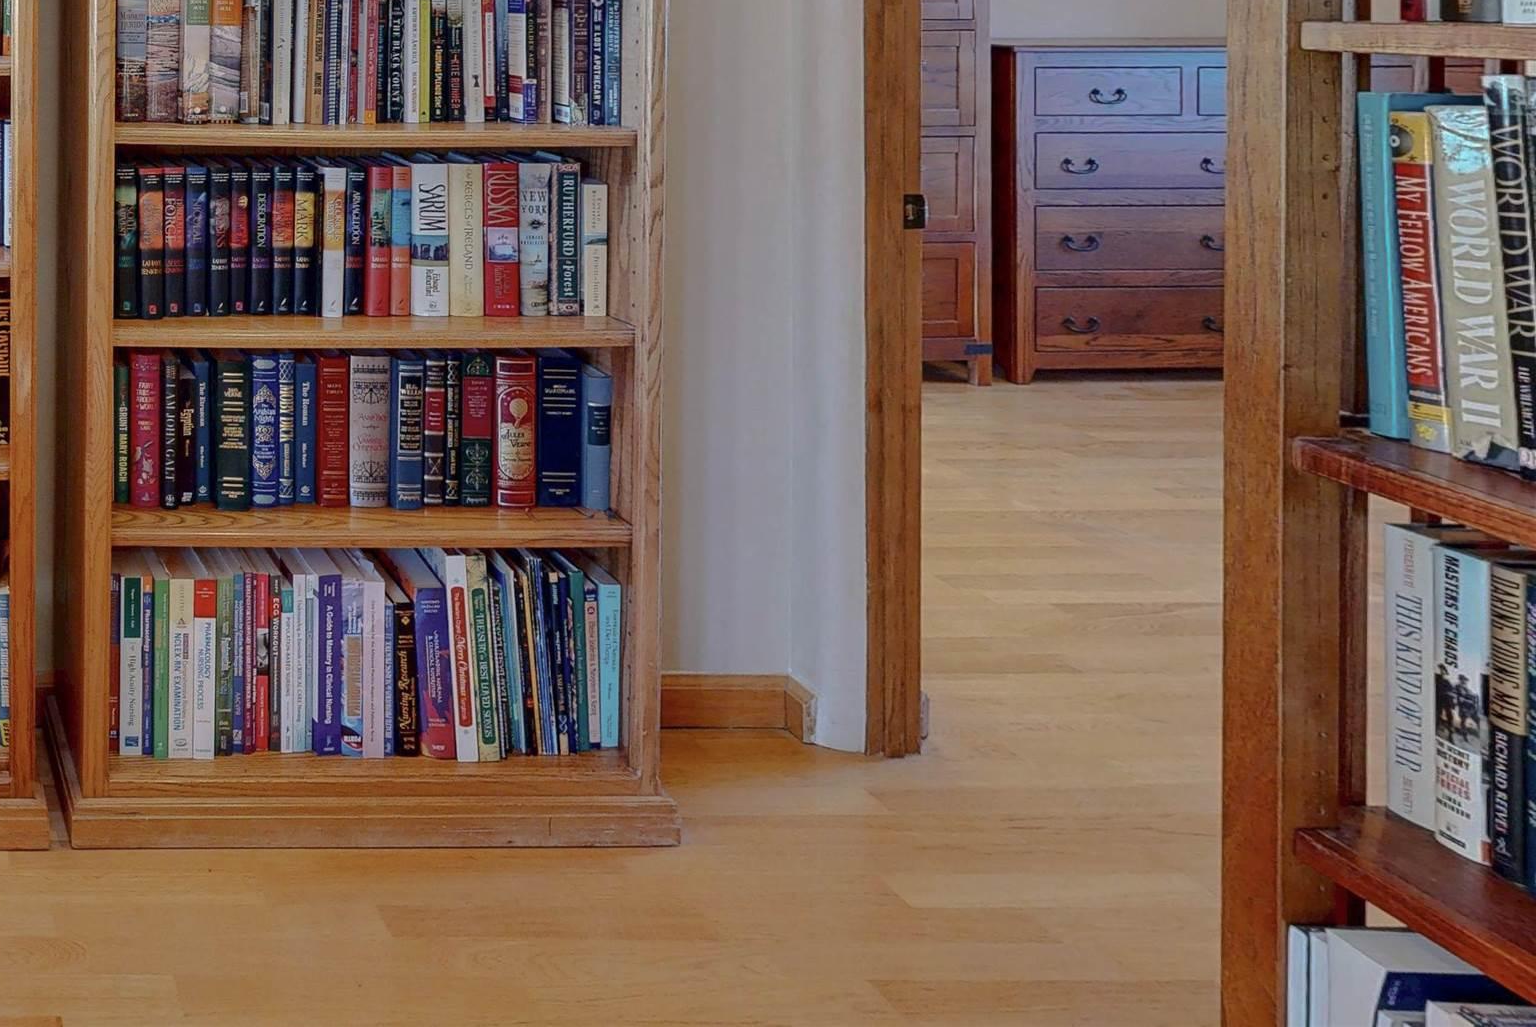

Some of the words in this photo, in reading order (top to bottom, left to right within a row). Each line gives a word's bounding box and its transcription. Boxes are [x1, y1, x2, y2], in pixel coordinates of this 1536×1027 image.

[392, 19, 400, 37] THE
[392, 40, 401, 68] BLACK
[392, 71, 401, 101] COUNT
[593, 55, 601, 105] APOTHECARY
[418, 184, 446, 231] SARUM
[487, 171, 517, 224] RUSSKA
[1394, 175, 1424, 202] MY
[1491, 125, 1531, 254] WORLD
[165, 197, 176, 243] FORCE
[192, 199, 202, 243] NICOLAE
[257, 193, 266, 248] DESECRATION
[296, 199, 308, 241] MARK
[352, 190, 360, 244] ARMAGEDDON
[562, 180, 575, 255] RUTHERFURD
[1397, 209, 1431, 270] FELLOW
[1447, 179, 1494, 304] WORLD
[563, 265, 575, 296] Forest
[1504, 264, 1536, 337] WAR
[1400, 277, 1434, 376] AMERICANS
[1455, 315, 1498, 387] WAR
[119, 407, 127, 431] GRUNT
[280, 384, 294, 414] MOBY
[1459, 399, 1502, 429] II
[180, 408, 194, 436] Egyptian
[280, 417, 294, 442] DICK
[119, 434, 127, 455] MARY
[119, 457, 128, 482] ROACH
[1444, 555, 1460, 609] MASTERS
[1490, 574, 1521, 631] DARING
[143, 609, 151, 652] Pharmacology
[272, 617, 280, 656] WORKOUT
[1444, 611, 1459, 626] OF
[196, 649, 204, 678] NURSING
[1444, 628, 1459, 668] CHAOS
[1490, 636, 1522, 689] YOUNG
[1490, 690, 1521, 727] MEN
[1494, 732, 1508, 789] RICHARD
[1495, 790, 1509, 833] REEVES
